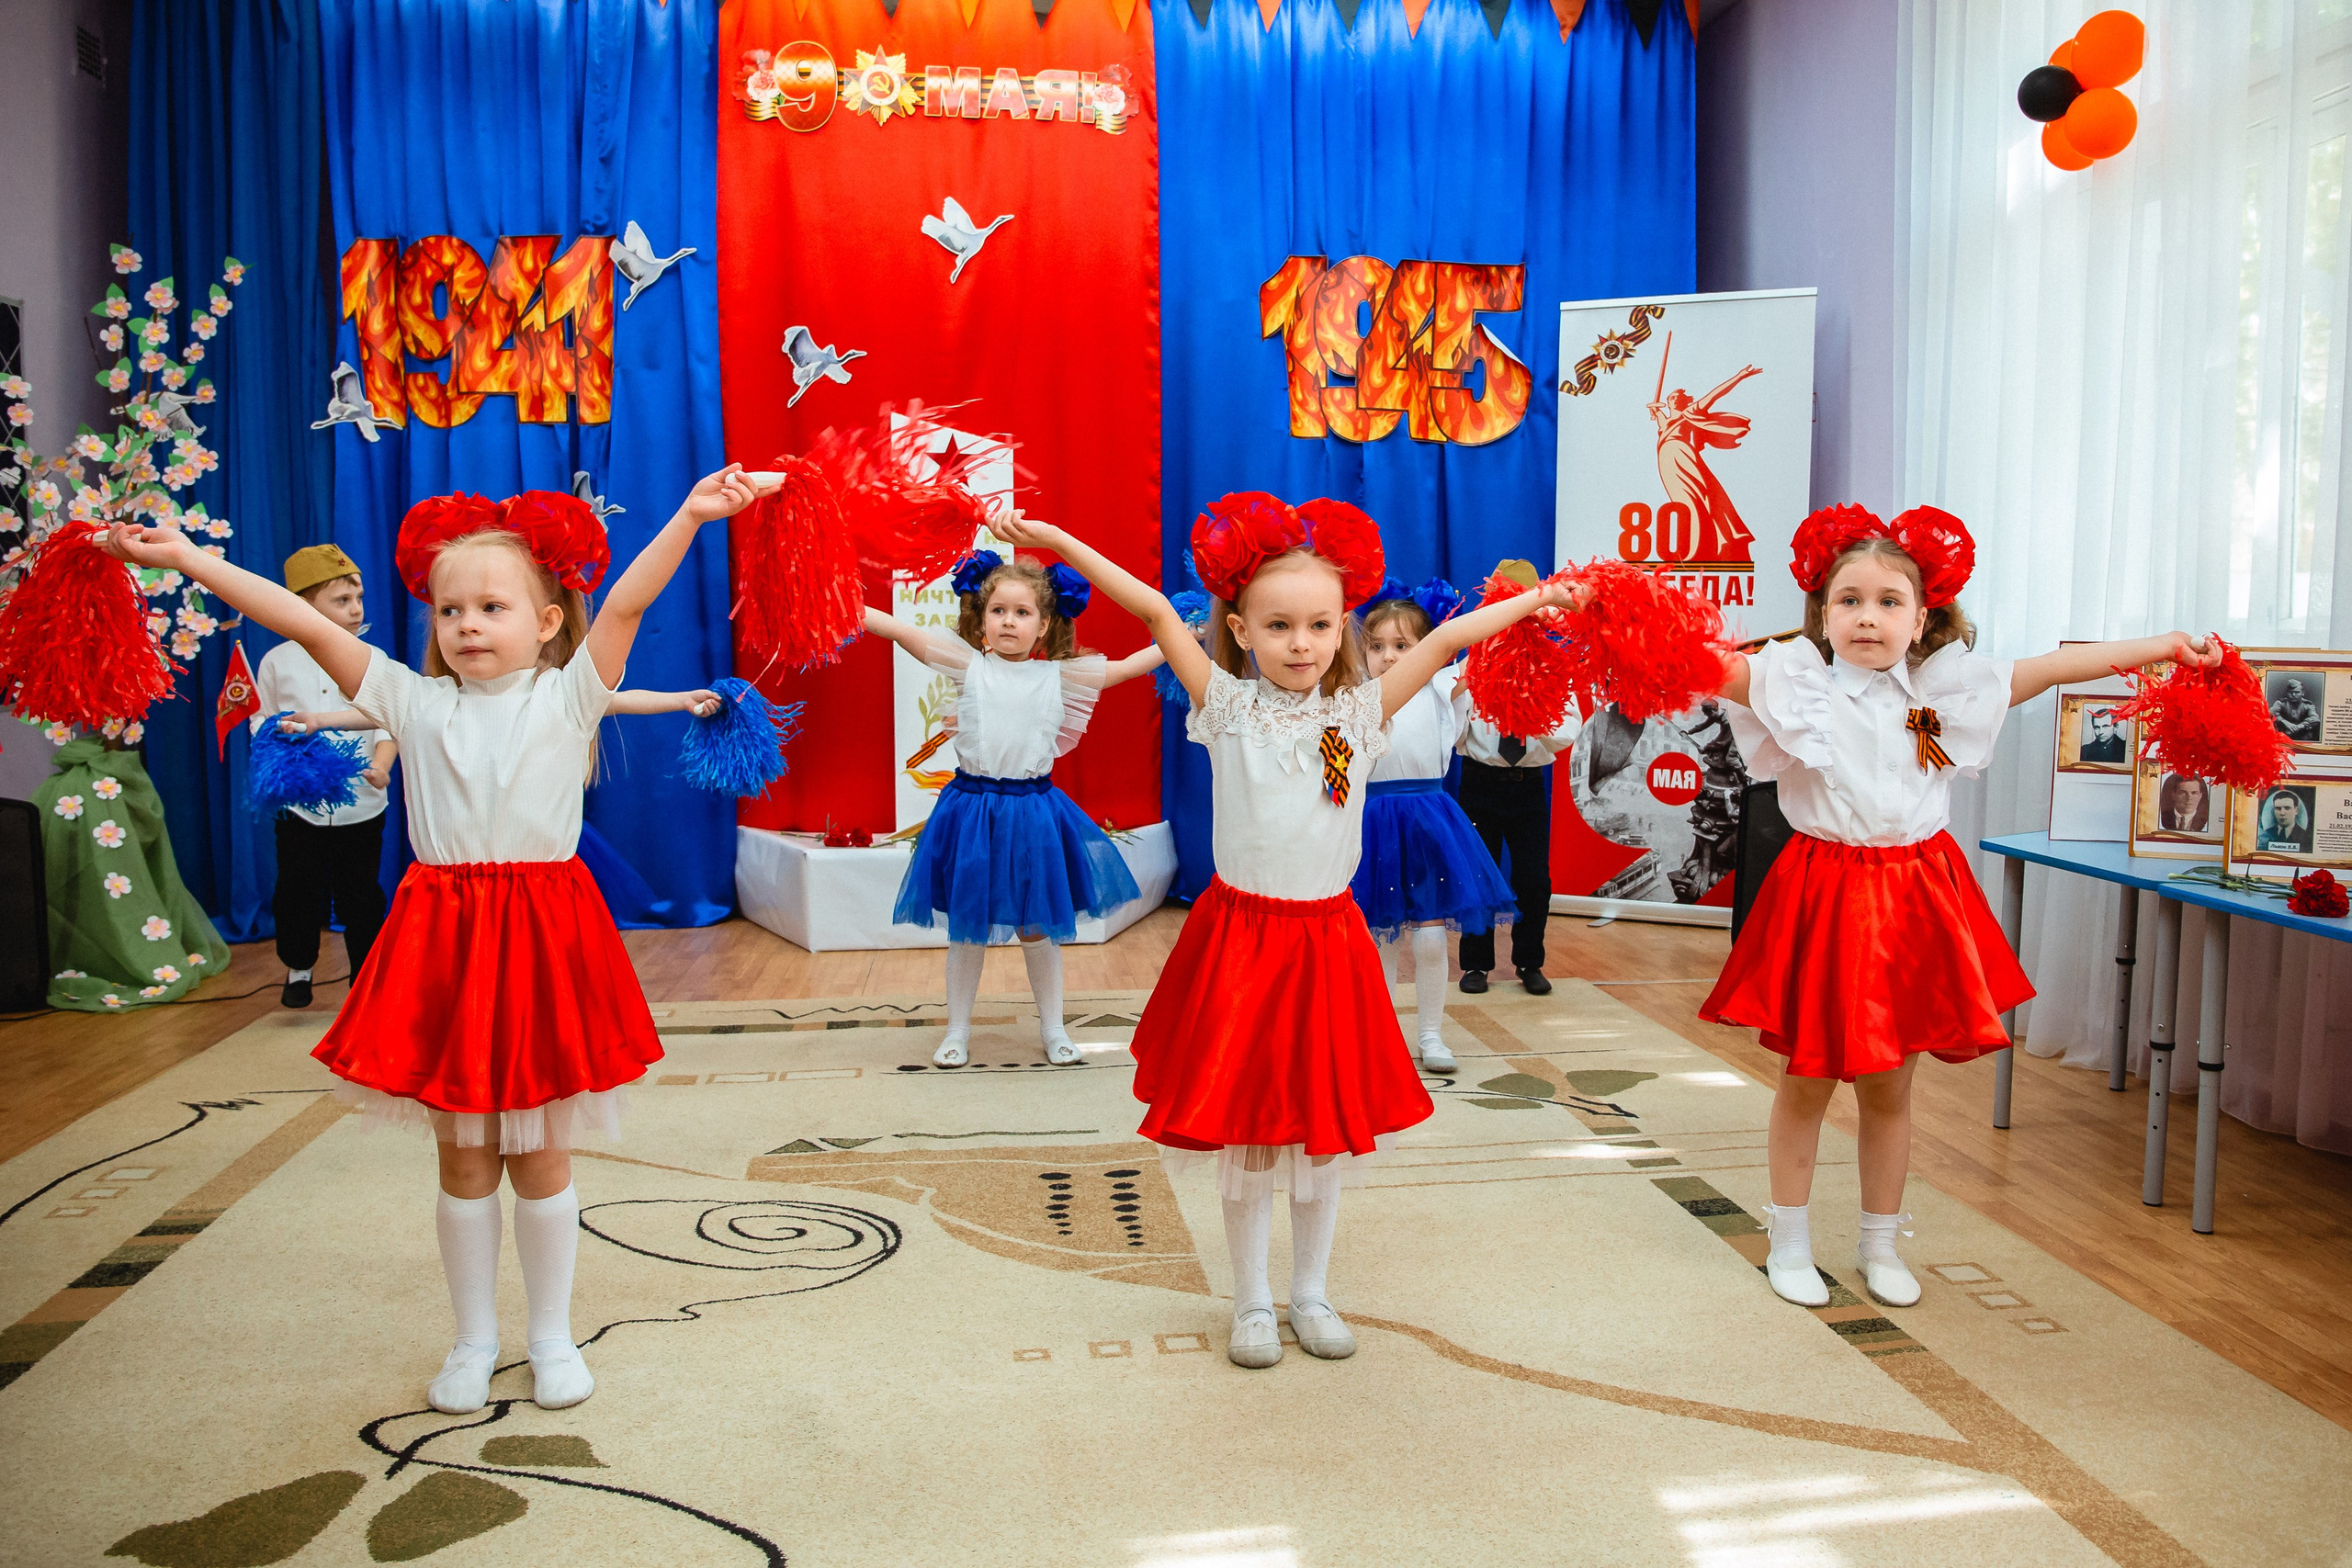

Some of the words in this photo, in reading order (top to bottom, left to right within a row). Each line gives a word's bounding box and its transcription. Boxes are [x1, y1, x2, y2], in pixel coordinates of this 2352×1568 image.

[773, 40, 838, 132] 9
[923, 65, 1098, 124] МАЯ!
[340, 234, 616, 429] 1941
[1259, 254, 1532, 446] 1945
[1618, 502, 1691, 562] 80
[899, 589, 955, 604] НИЧТ
[1657, 575, 1755, 611] ЕДА!
[915, 613, 956, 627] ЗАБ
[1653, 768, 1697, 790] МАЯ
